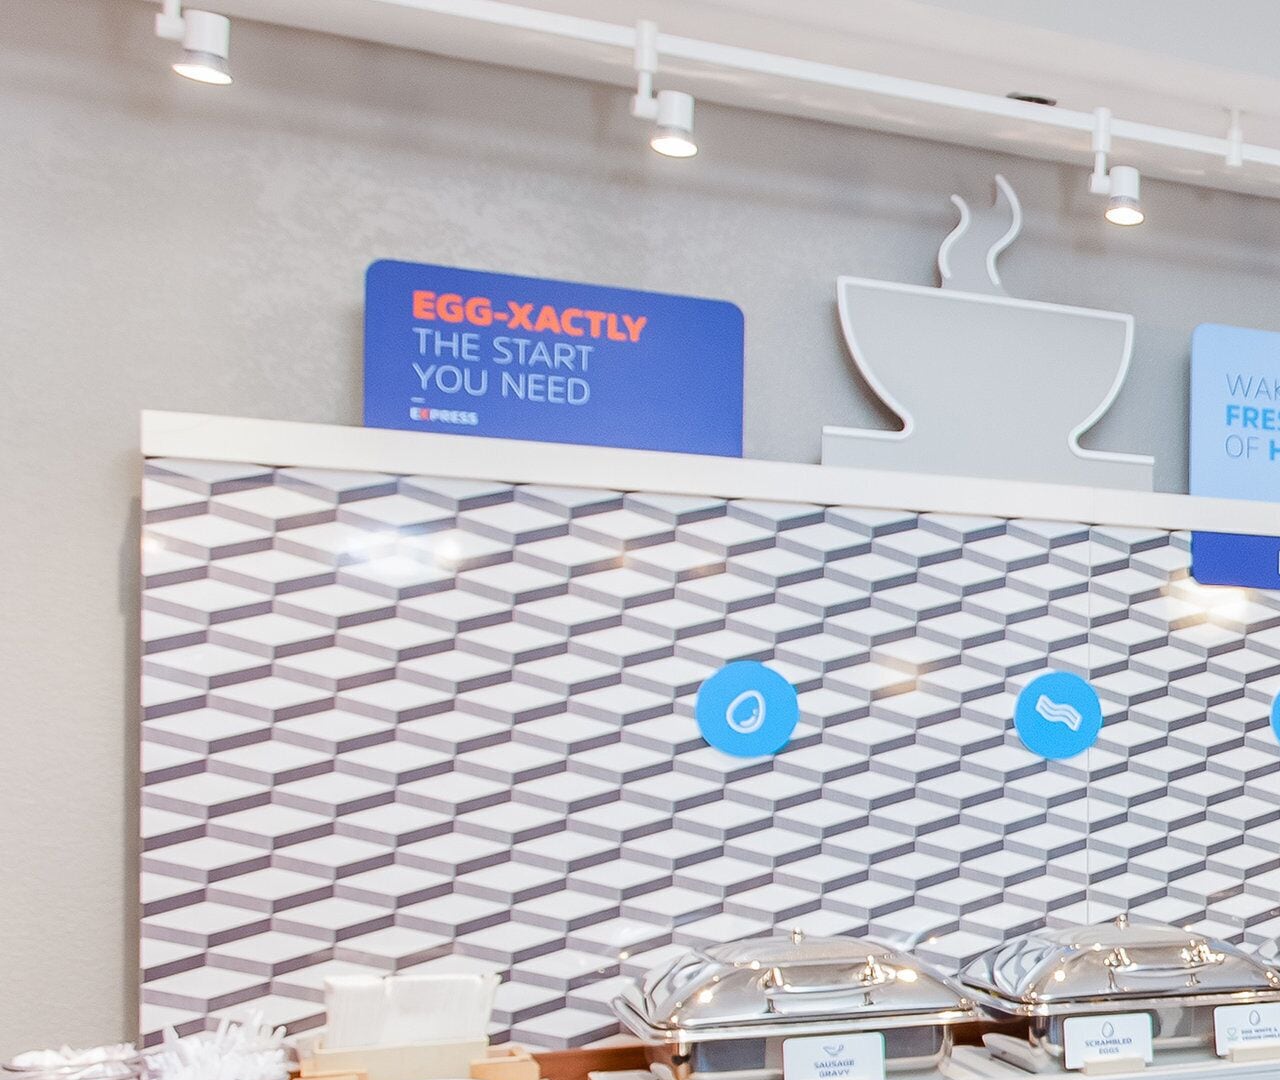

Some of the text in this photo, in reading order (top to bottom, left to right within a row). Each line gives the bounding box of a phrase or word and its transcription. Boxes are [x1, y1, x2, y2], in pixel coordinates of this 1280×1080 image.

[411, 290, 647, 342] EGG-XACTLY
[411, 327, 595, 372] THE START
[411, 363, 591, 405] YOU NEED
[410, 406, 479, 426] EXPRESS
[1225, 434, 1259, 459] OF
[1084, 1037, 1133, 1047] SCRAMBLED
[814, 1059, 855, 1069] SAUSAGE
[819, 1069, 850, 1078] GRAVY
